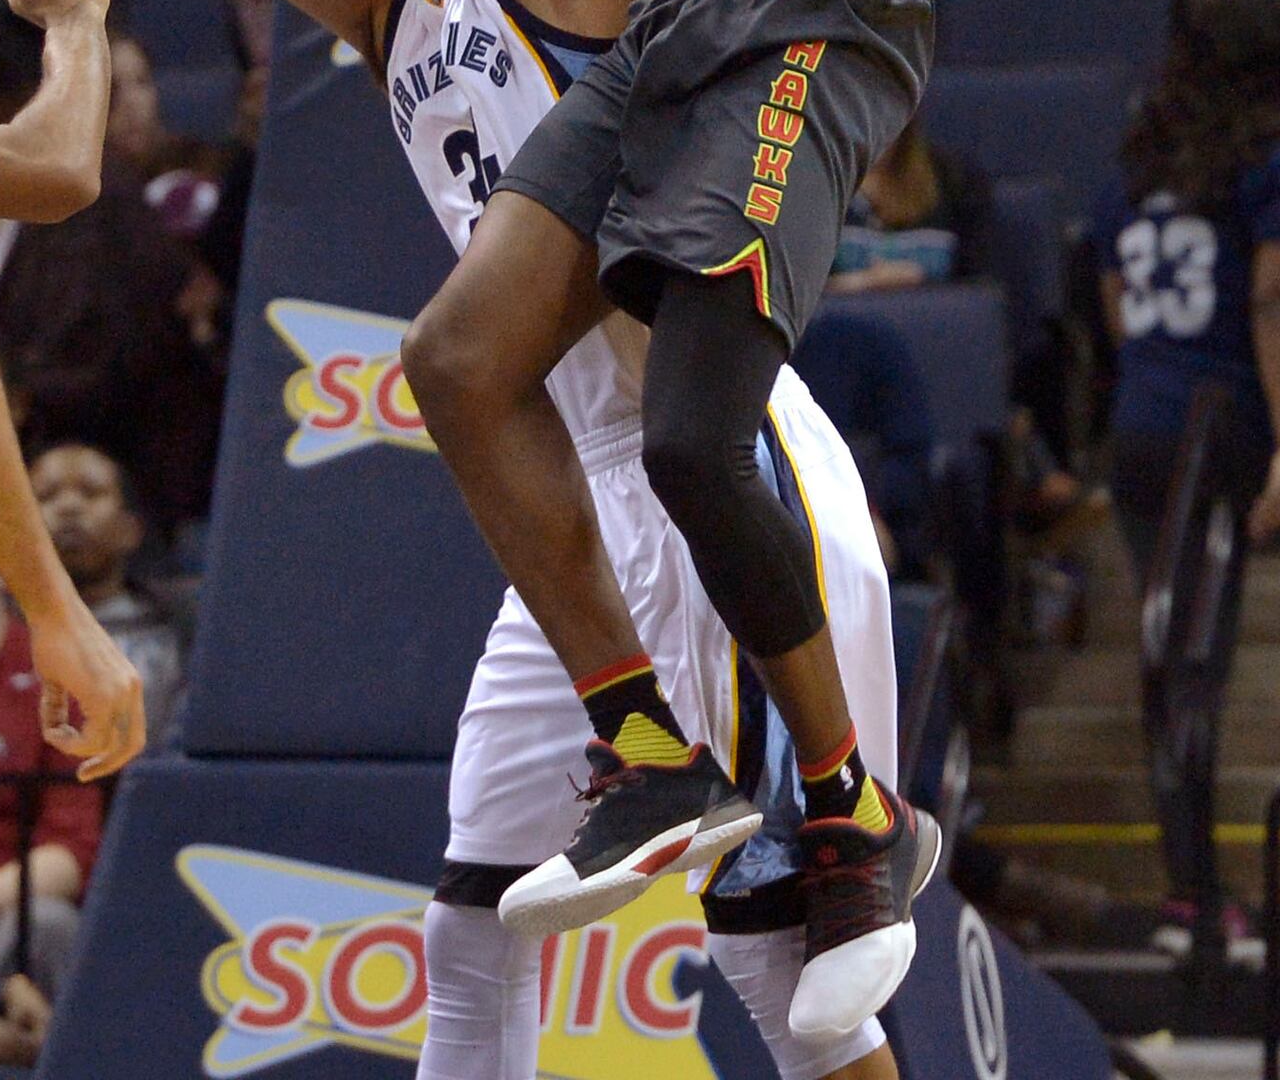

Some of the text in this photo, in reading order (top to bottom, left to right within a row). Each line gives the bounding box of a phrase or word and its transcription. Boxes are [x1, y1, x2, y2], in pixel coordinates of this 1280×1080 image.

[443, 128, 502, 237] 3
[744, 39, 827, 226] HAWKS
[235, 923, 707, 1031] SOIC
